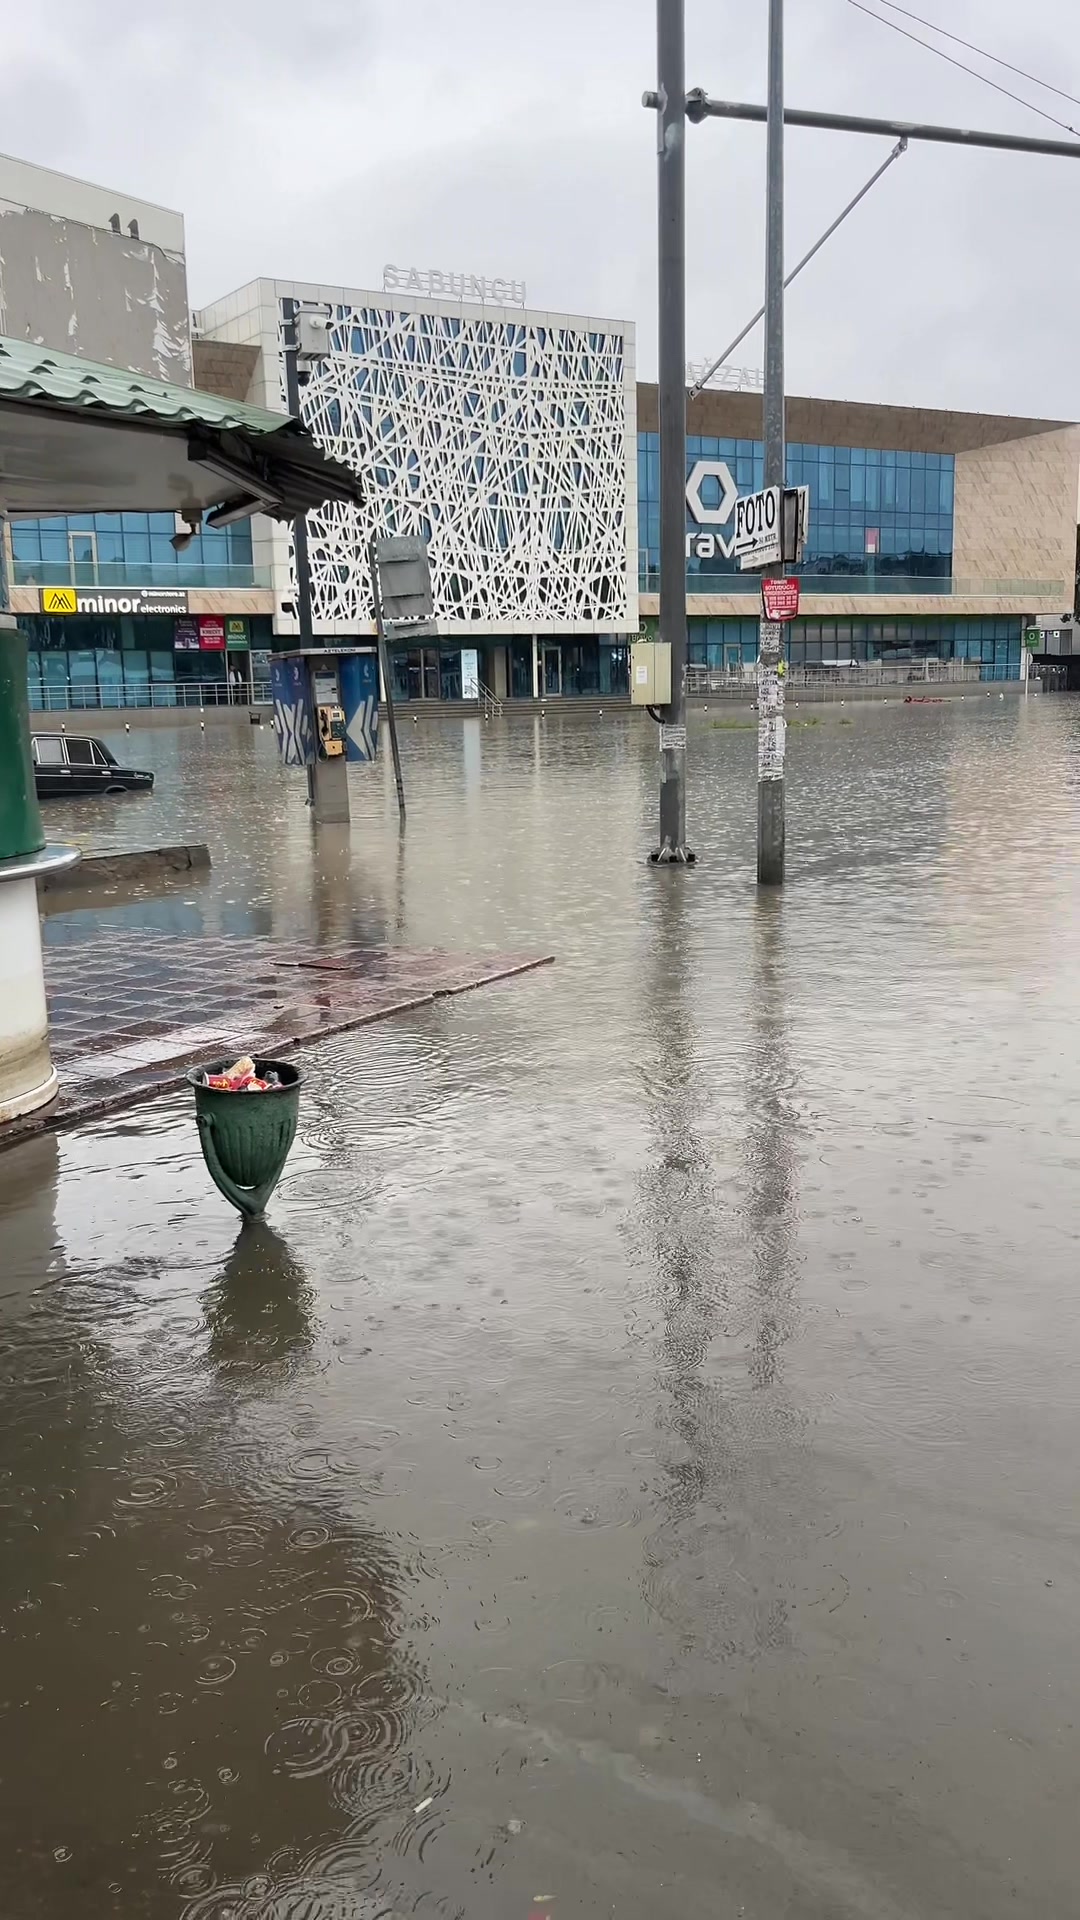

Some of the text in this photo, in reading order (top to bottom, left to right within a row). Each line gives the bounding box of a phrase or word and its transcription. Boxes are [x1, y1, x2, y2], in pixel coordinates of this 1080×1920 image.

[384, 264, 526, 305] SABUNÇU
[736, 490, 775, 538] FOTO
[686, 532, 736, 558] rav
[77, 595, 187, 614] minor electronics
